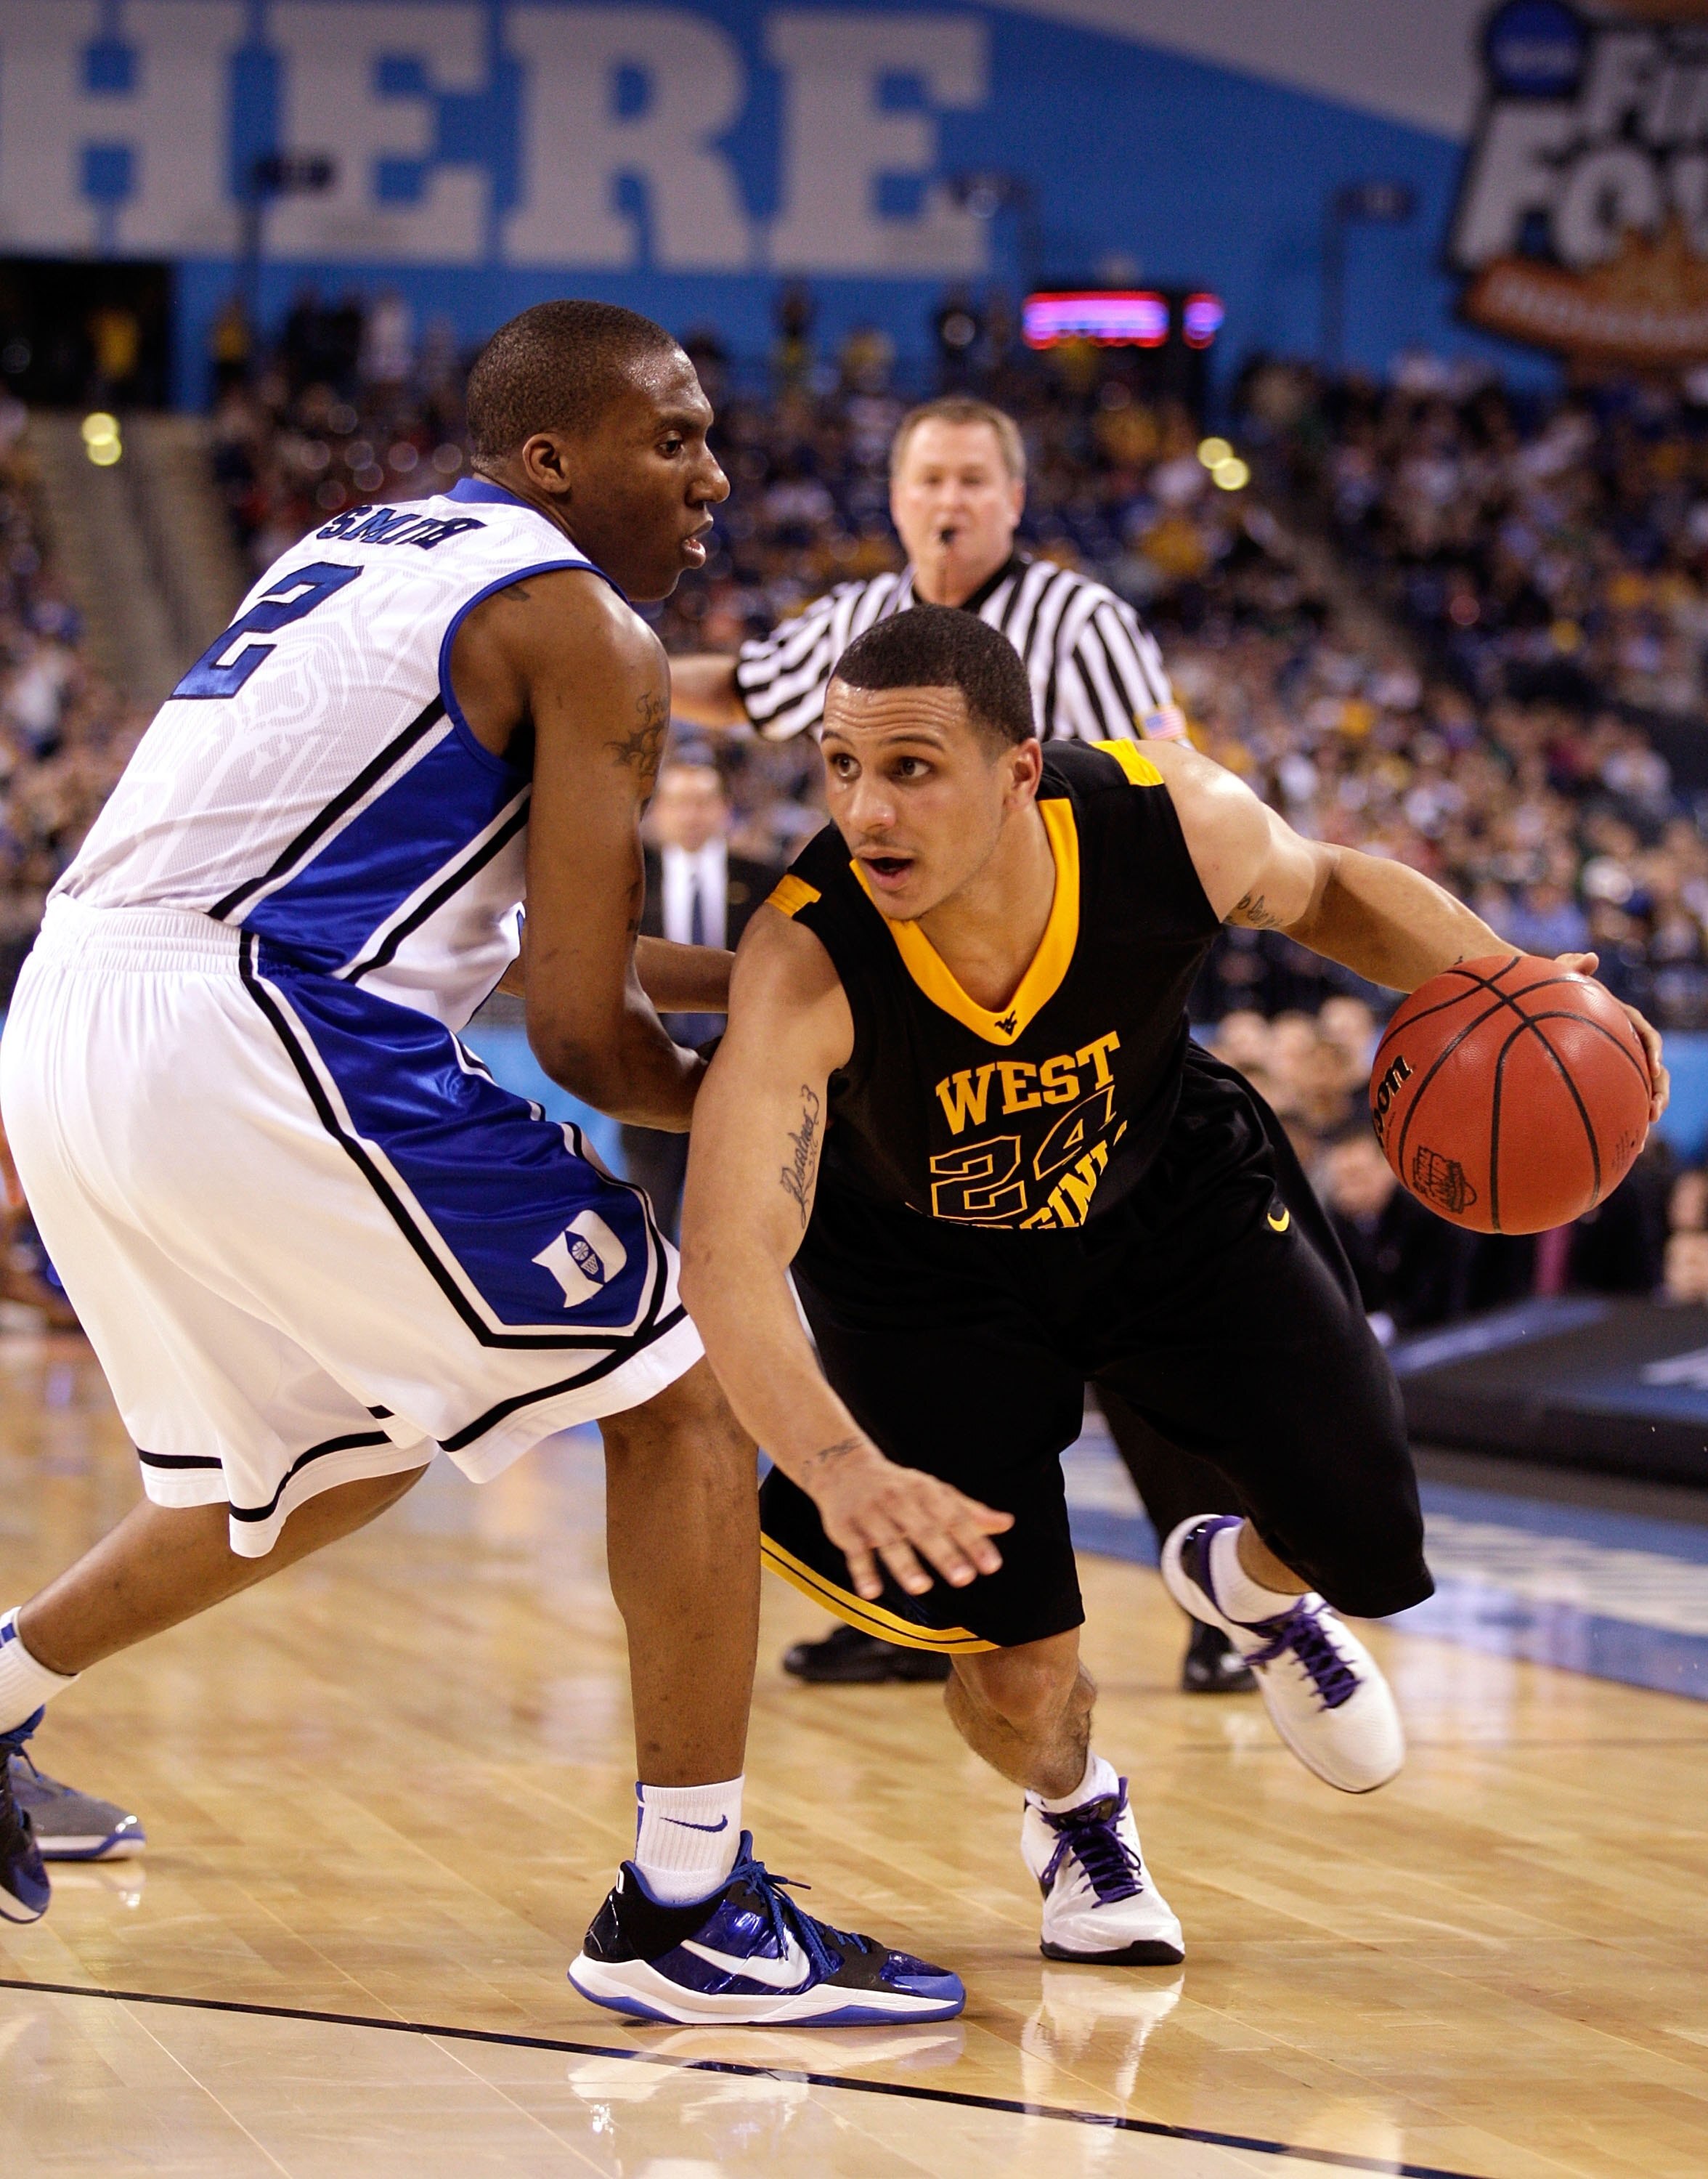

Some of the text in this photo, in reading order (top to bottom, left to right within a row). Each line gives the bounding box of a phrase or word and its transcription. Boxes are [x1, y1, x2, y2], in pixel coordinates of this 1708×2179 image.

[0, 3, 990, 275] HERE
[167, 561, 364, 700] 2
[935, 1030, 1121, 1135] WEST
[930, 1084, 1117, 1221] 24
